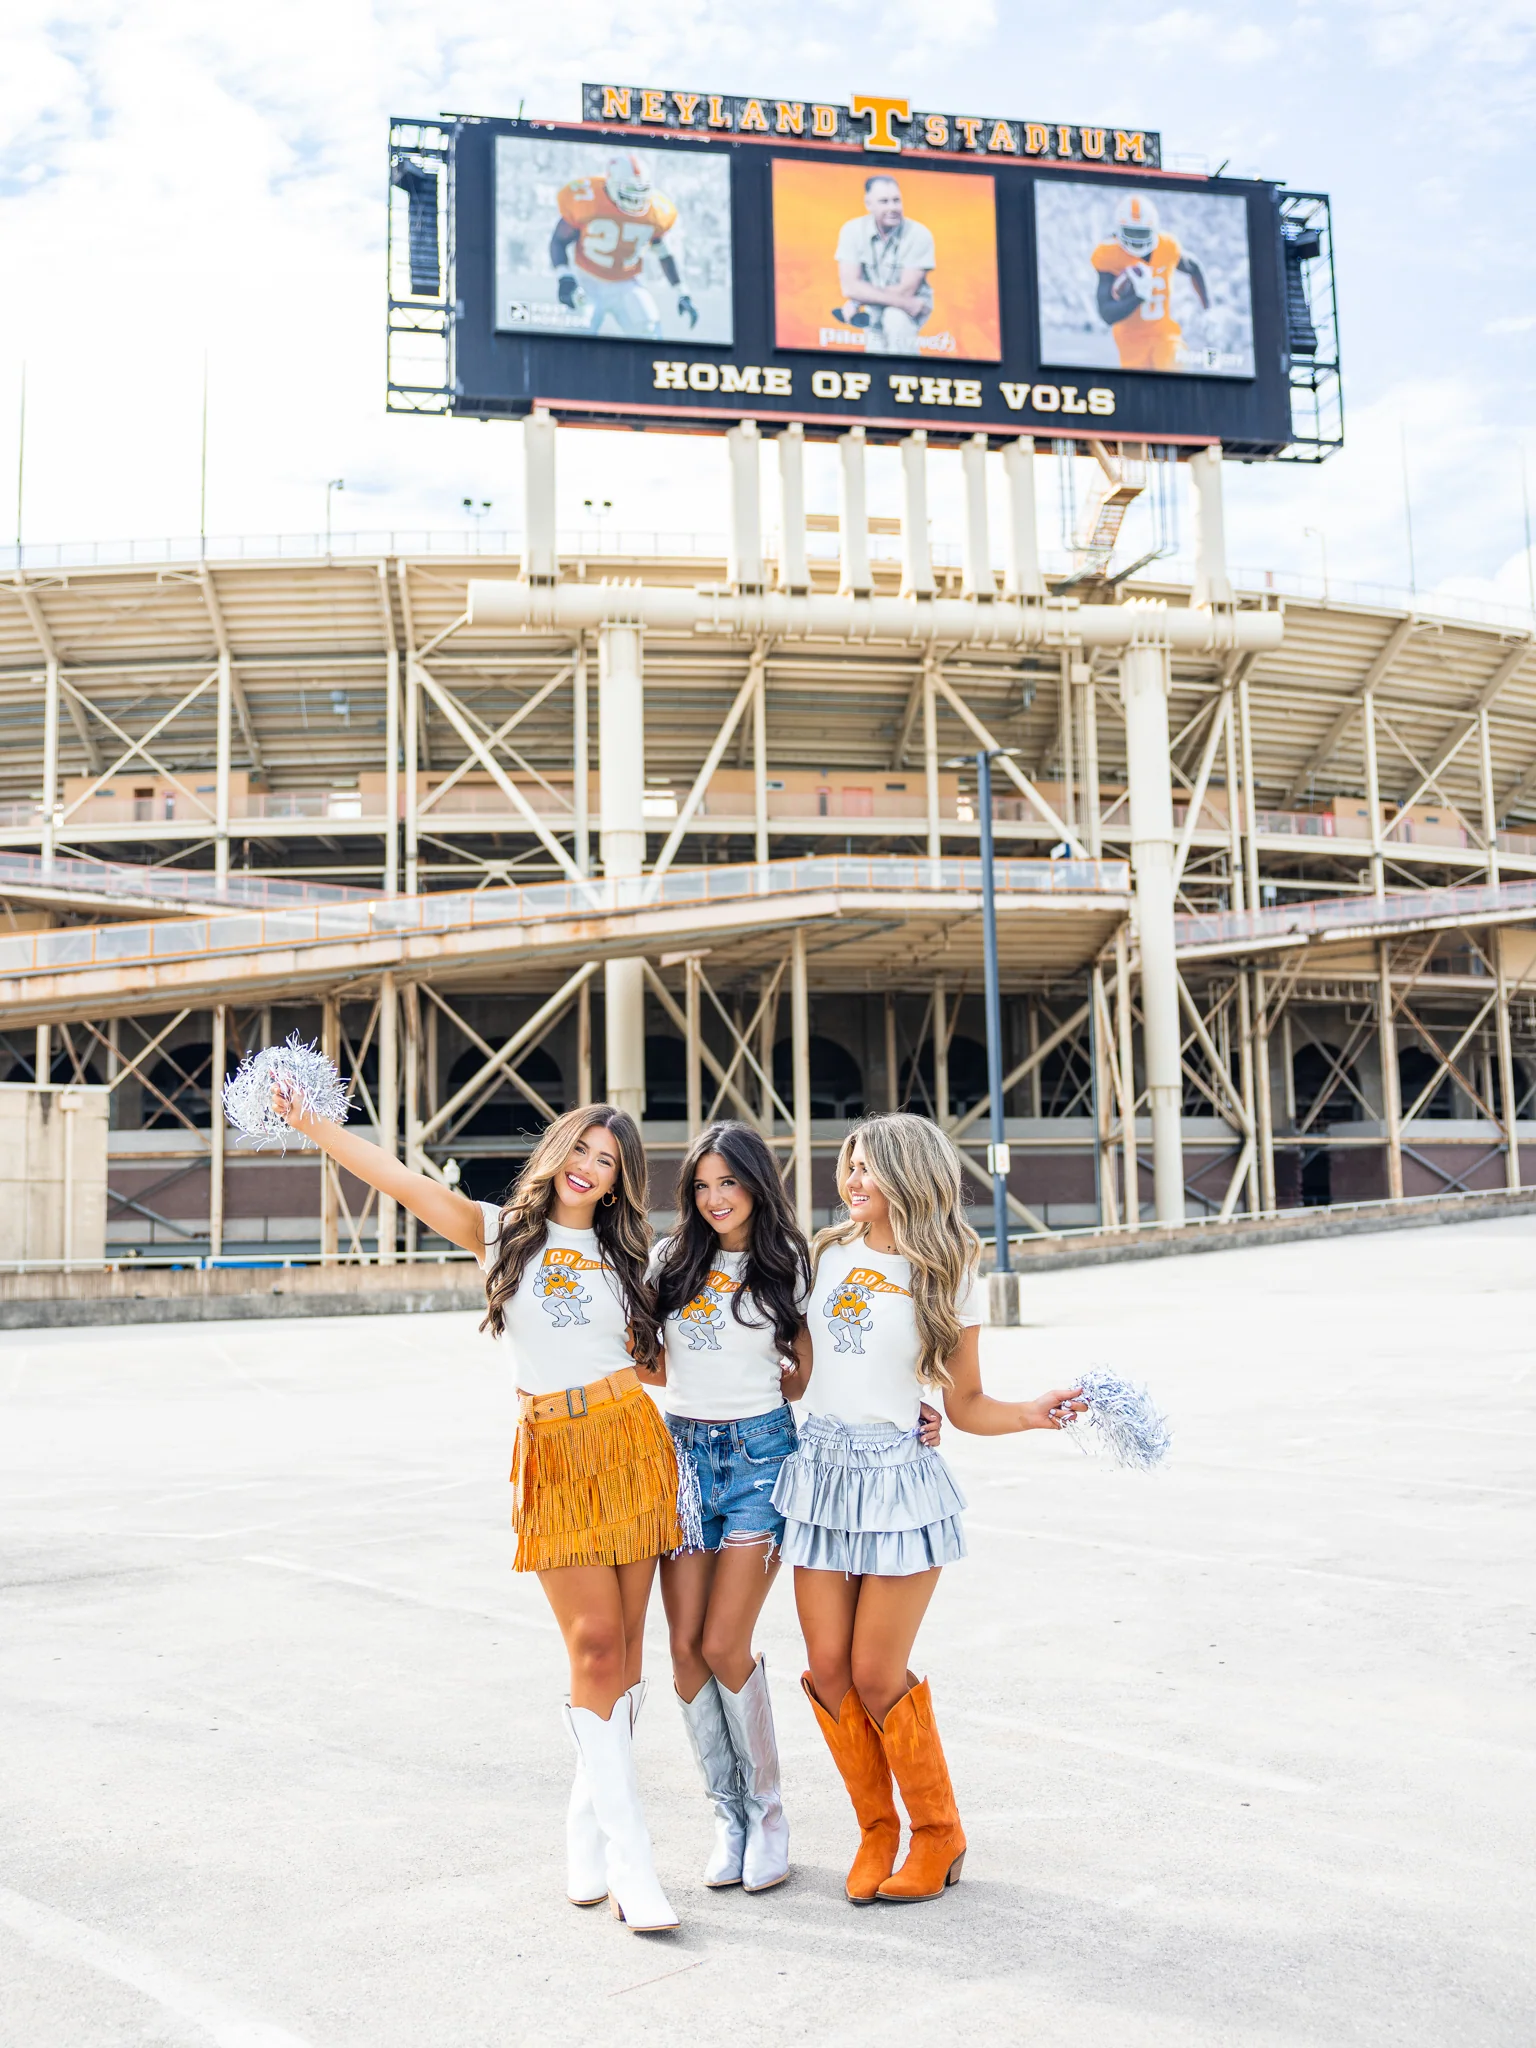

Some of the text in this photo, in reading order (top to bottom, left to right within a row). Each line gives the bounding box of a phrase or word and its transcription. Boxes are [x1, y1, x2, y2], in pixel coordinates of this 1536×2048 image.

[602, 86, 1146, 162] NEYLAND T STADIUM
[583, 218, 655, 268] 27
[652, 361, 1116, 416] HOME OF THE VOLS
[549, 1251, 575, 1264] GO
[852, 1271, 878, 1285] GO
